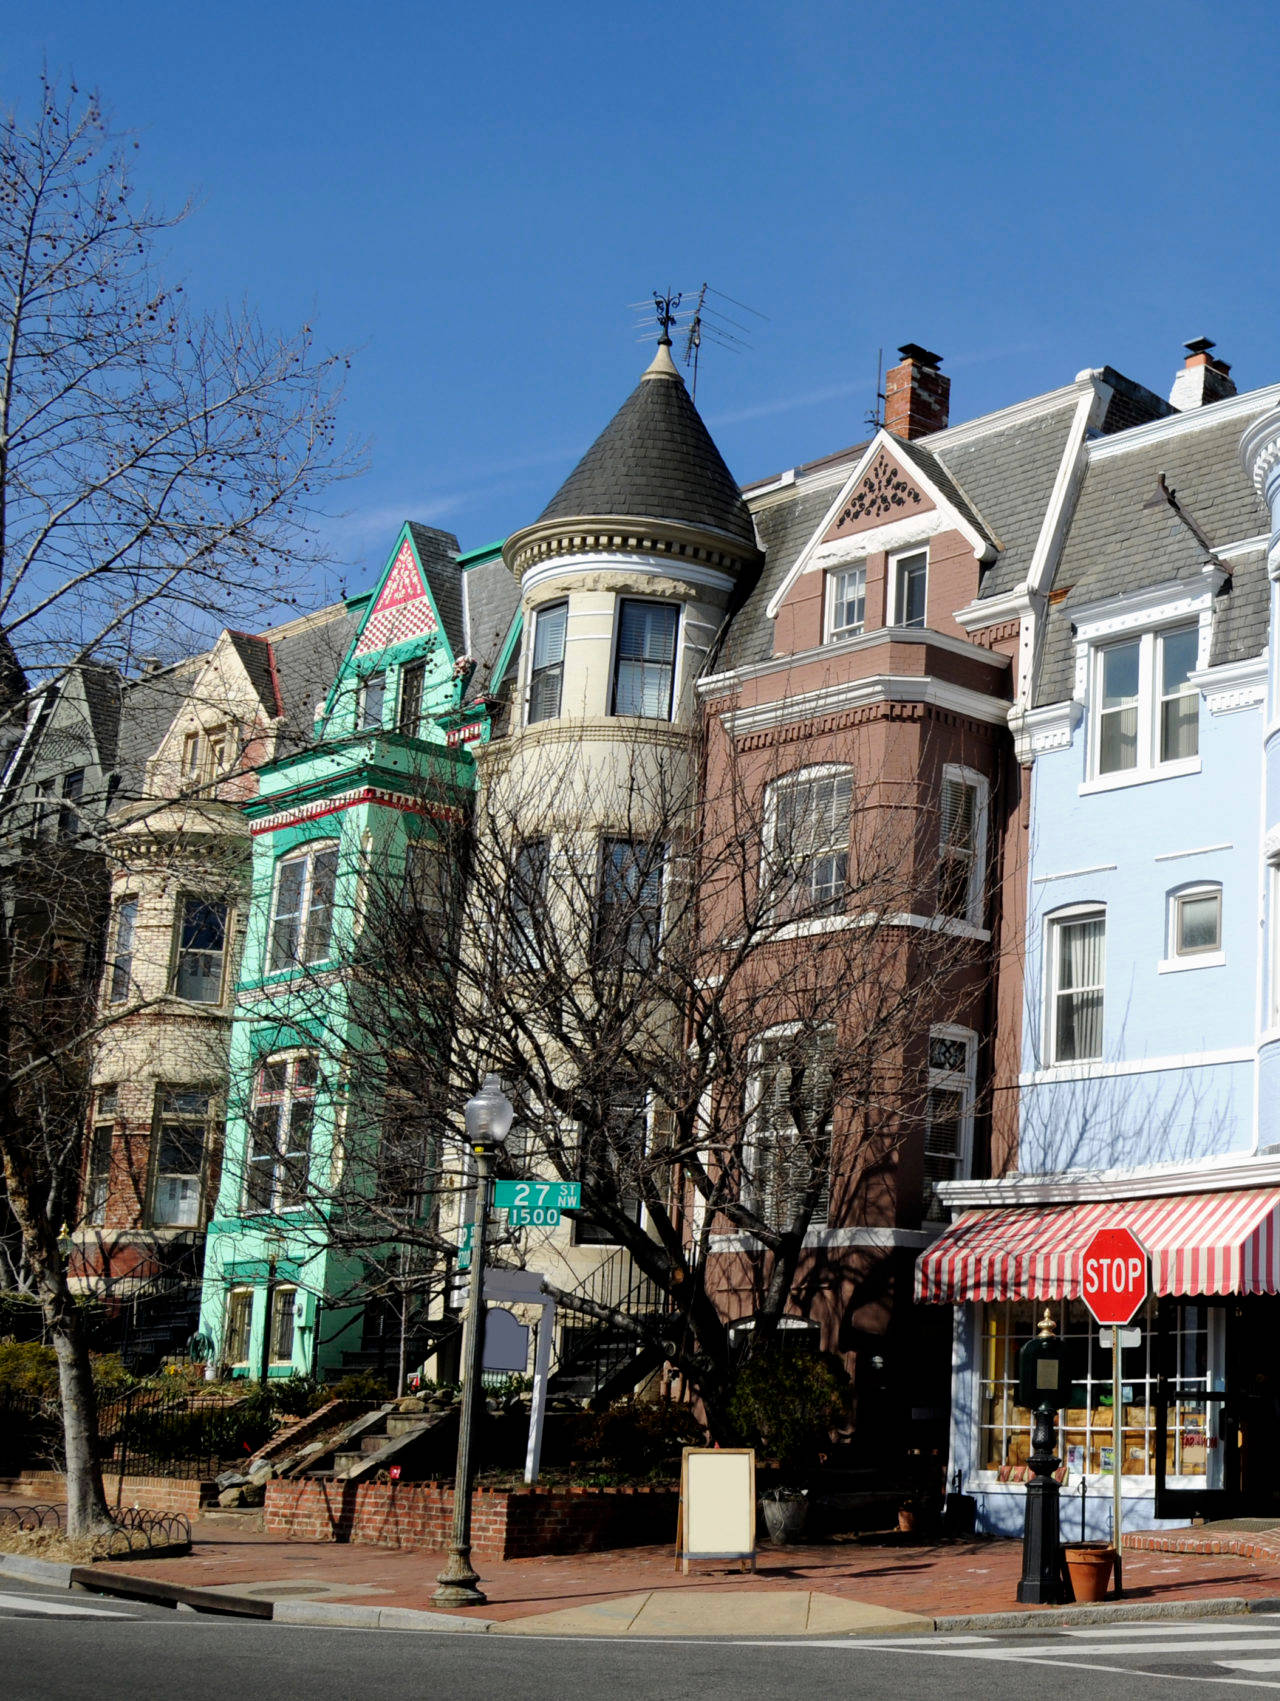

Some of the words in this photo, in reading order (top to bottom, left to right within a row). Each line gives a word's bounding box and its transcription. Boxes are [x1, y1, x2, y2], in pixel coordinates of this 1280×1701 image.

[514, 1184, 550, 1206] 27
[560, 1185, 576, 1196] ST
[558, 1196, 577, 1207] NW
[513, 1208, 558, 1224] 1500
[1086, 1257, 1142, 1293] STOP
